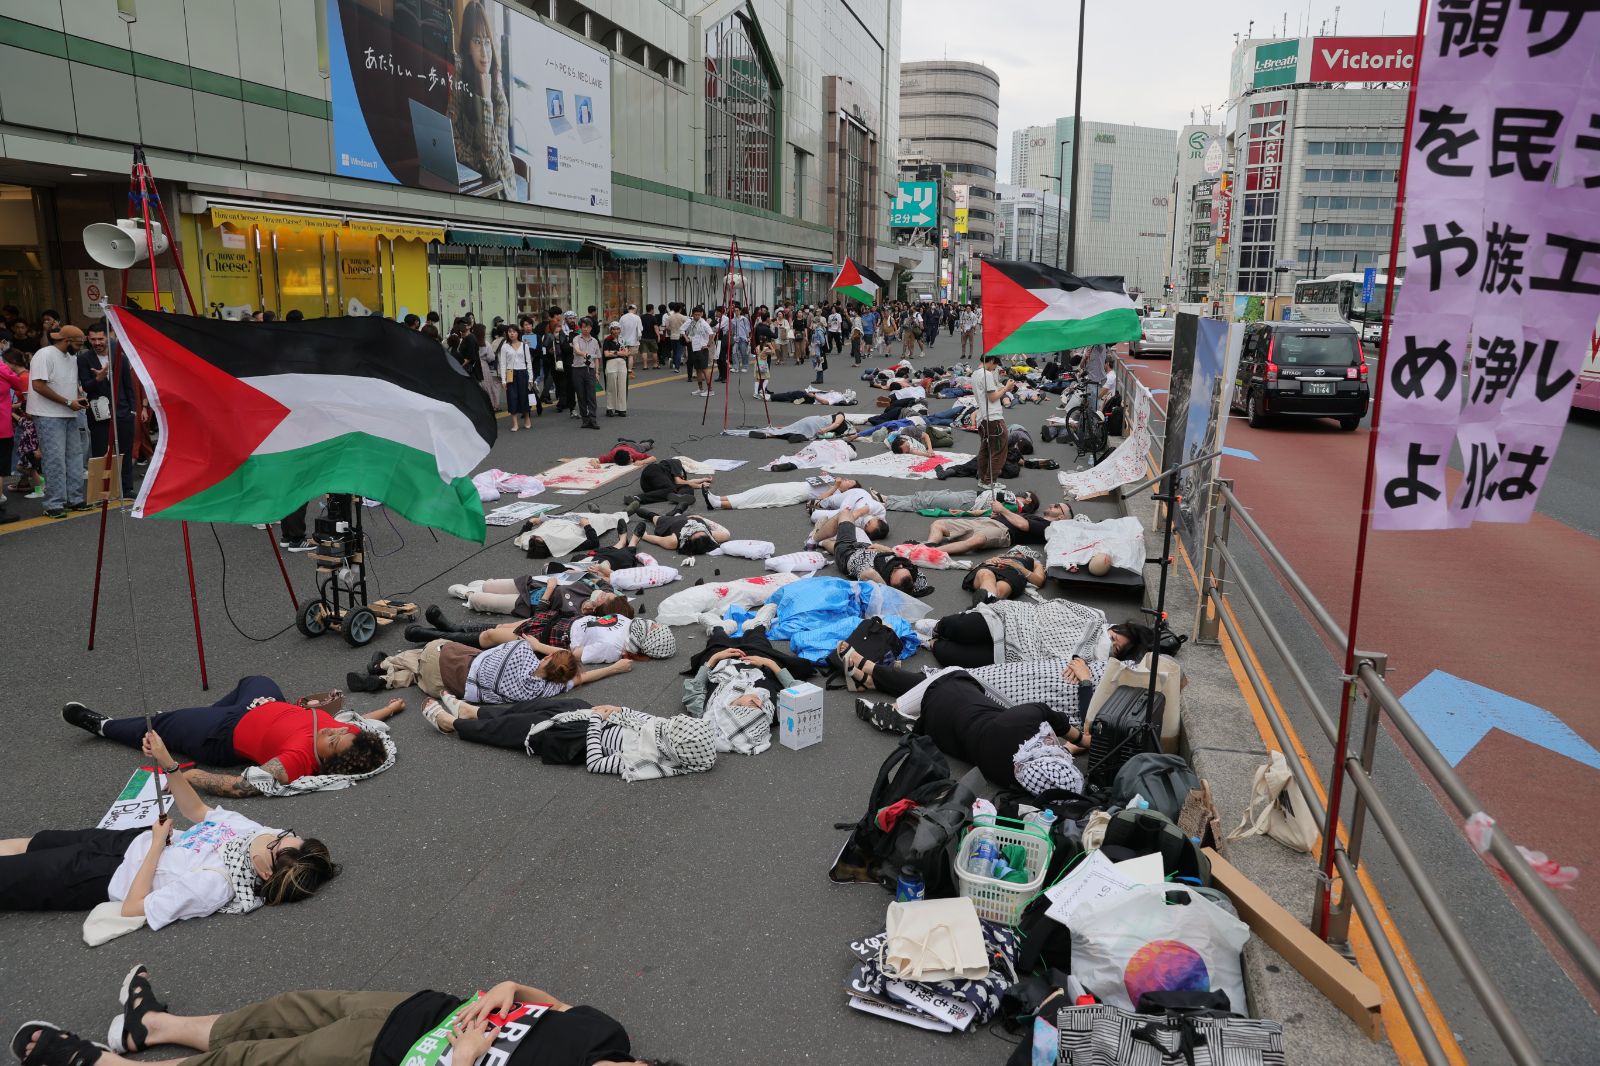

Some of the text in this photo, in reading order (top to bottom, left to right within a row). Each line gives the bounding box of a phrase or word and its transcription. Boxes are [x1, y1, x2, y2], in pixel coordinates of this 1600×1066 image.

[1255, 55, 1299, 70] L-Breath
[1188, 151, 1205, 159] JR
[351, 157, 373, 168] Windows
